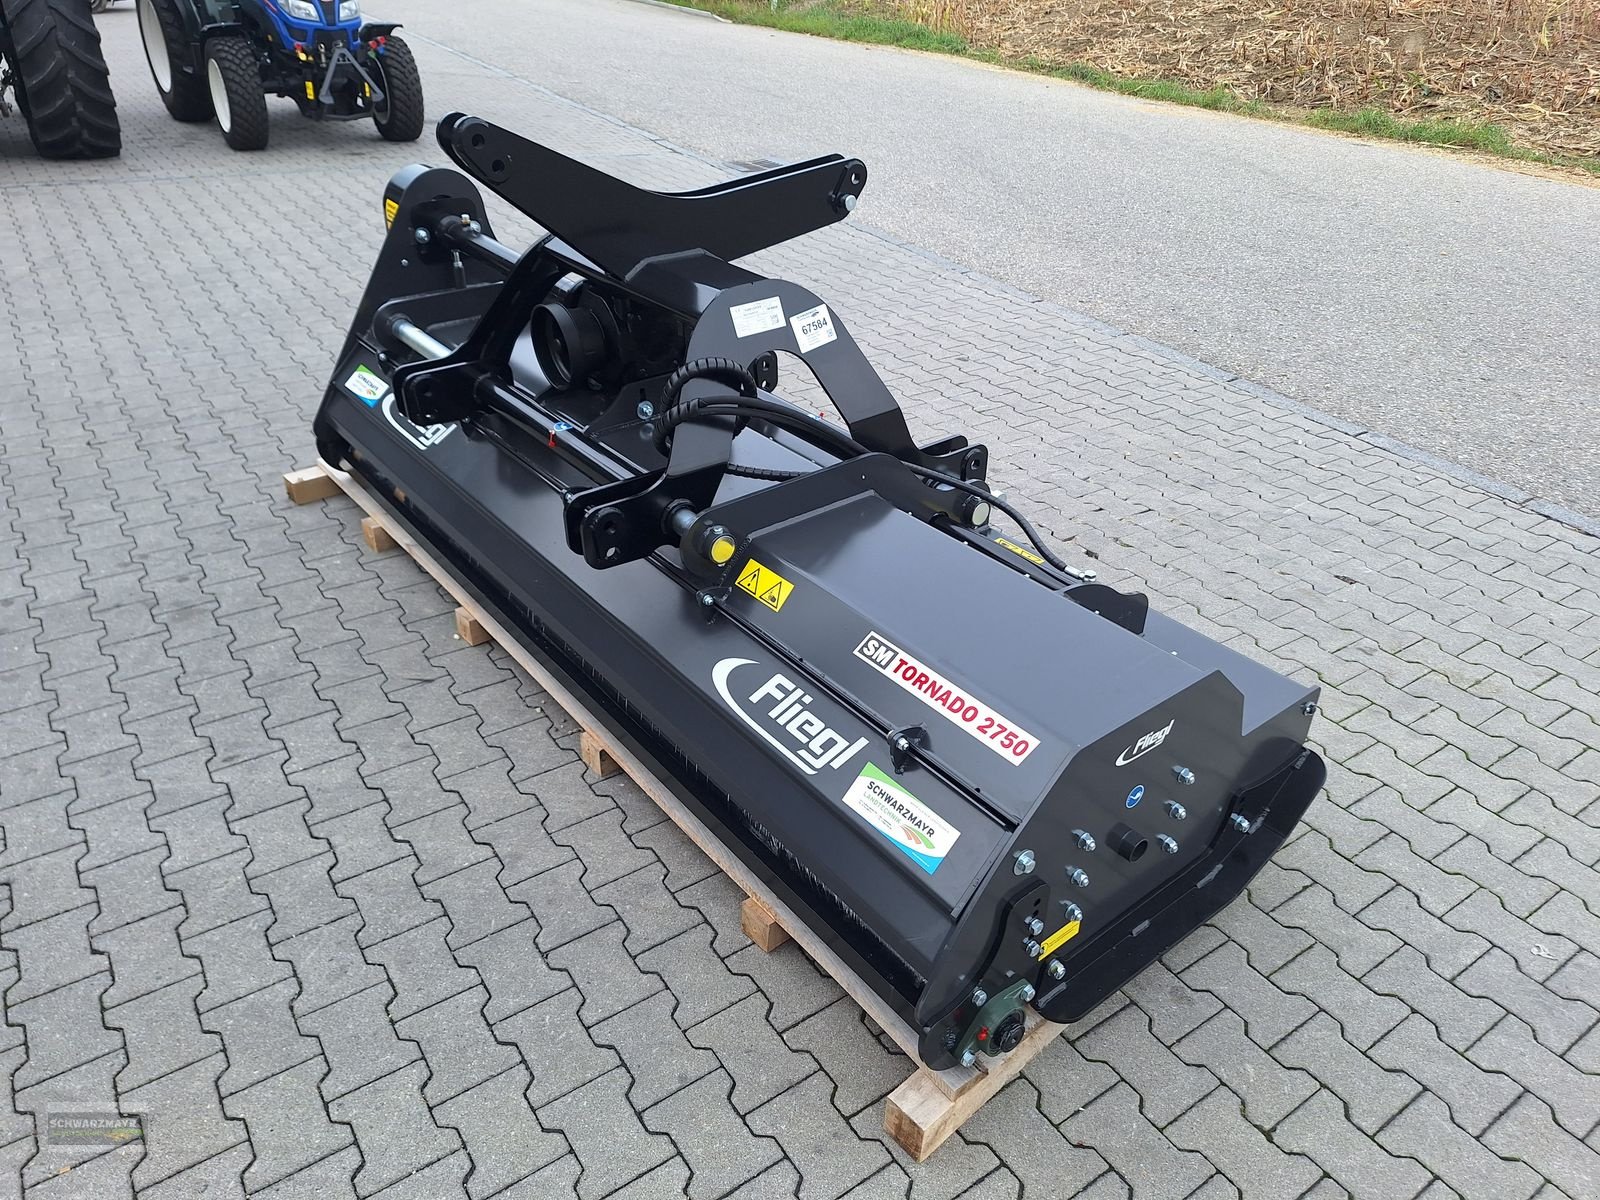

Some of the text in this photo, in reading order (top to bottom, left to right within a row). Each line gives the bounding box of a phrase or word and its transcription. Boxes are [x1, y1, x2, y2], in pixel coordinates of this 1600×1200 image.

[801, 317, 828, 335] 67584
[748, 673, 870, 770] Fliegl
[862, 639, 1030, 757] SM TORNADO 2750
[1133, 718, 1176, 754] Fliegl
[862, 791, 903, 825] LANDTECHNIK
[866, 780, 936, 838] SCHWARZMAYR
